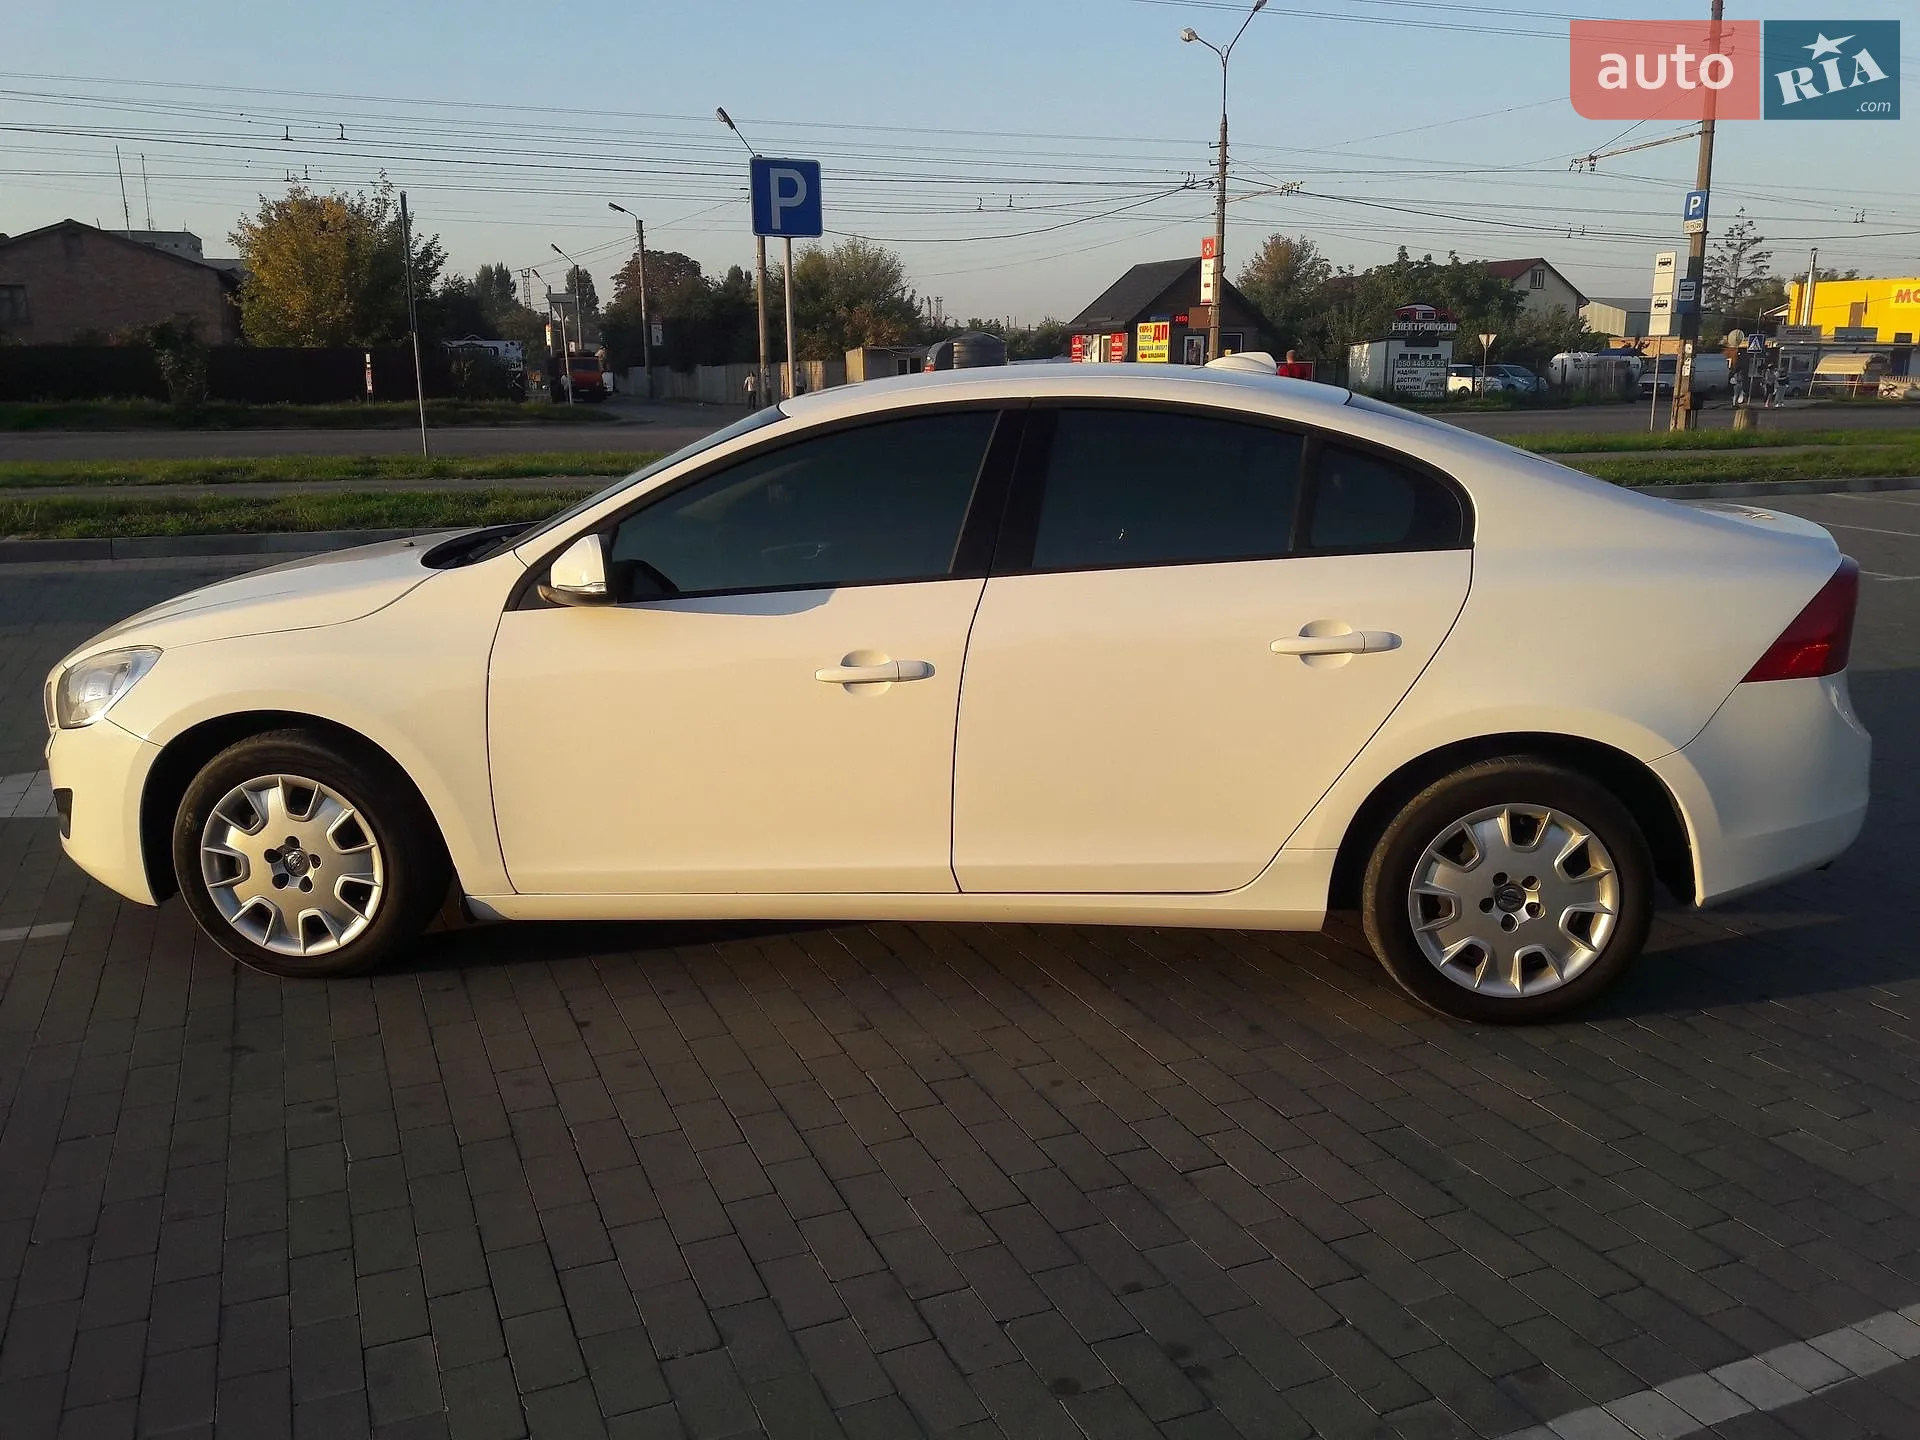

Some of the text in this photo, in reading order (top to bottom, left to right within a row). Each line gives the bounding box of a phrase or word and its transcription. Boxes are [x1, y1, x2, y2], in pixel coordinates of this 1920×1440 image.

[769, 167, 807, 230] P
[1688, 195, 1701, 216] P
[1152, 324, 1168, 343] ДП
